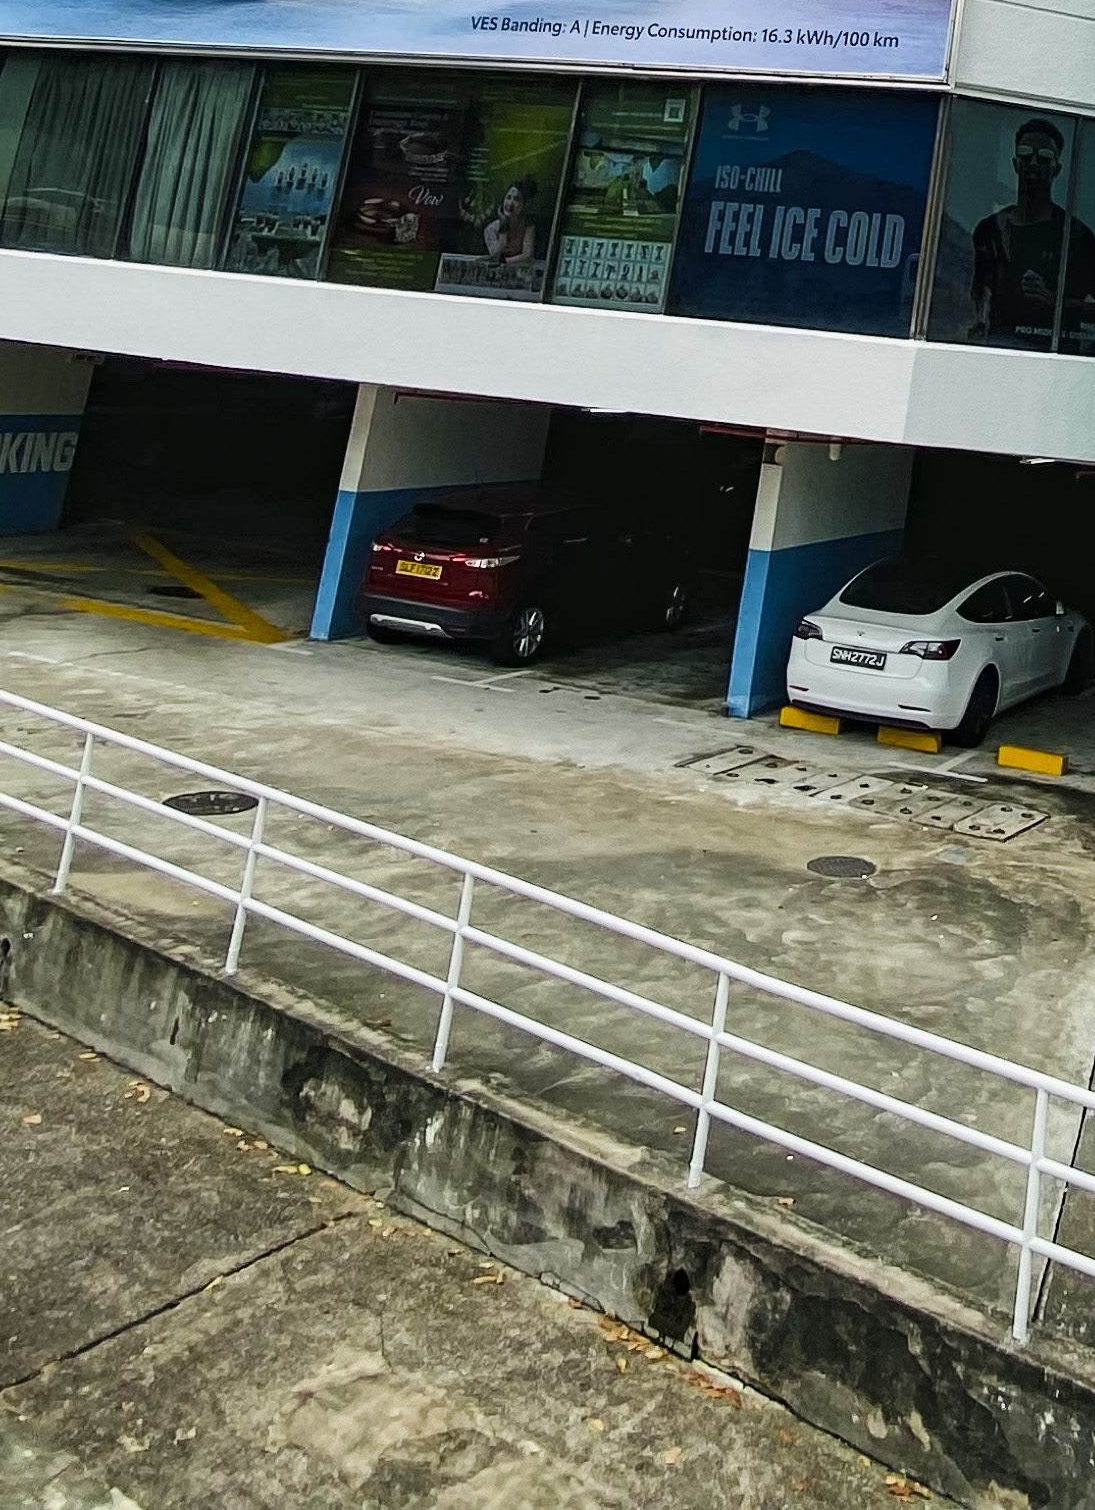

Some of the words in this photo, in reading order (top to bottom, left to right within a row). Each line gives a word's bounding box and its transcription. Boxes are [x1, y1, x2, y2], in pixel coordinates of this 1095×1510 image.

[471, 16, 498, 31] VES
[500, 17, 567, 37] Banding:
[569, 19, 581, 35] A
[592, 21, 644, 40] Energy
[647, 23, 757, 43] Consumption:
[761, 28, 793, 44] 16.3
[796, 29, 870, 49] kWh/100
[873, 32, 899, 48] km
[715, 164, 783, 194] ISO-CHILL
[704, 200, 765, 258] FEEL
[768, 206, 821, 262] ICE
[824, 209, 906, 269] COLD
[0, 432, 79, 473] KING
[832, 648, 885, 667] SNH2772J
